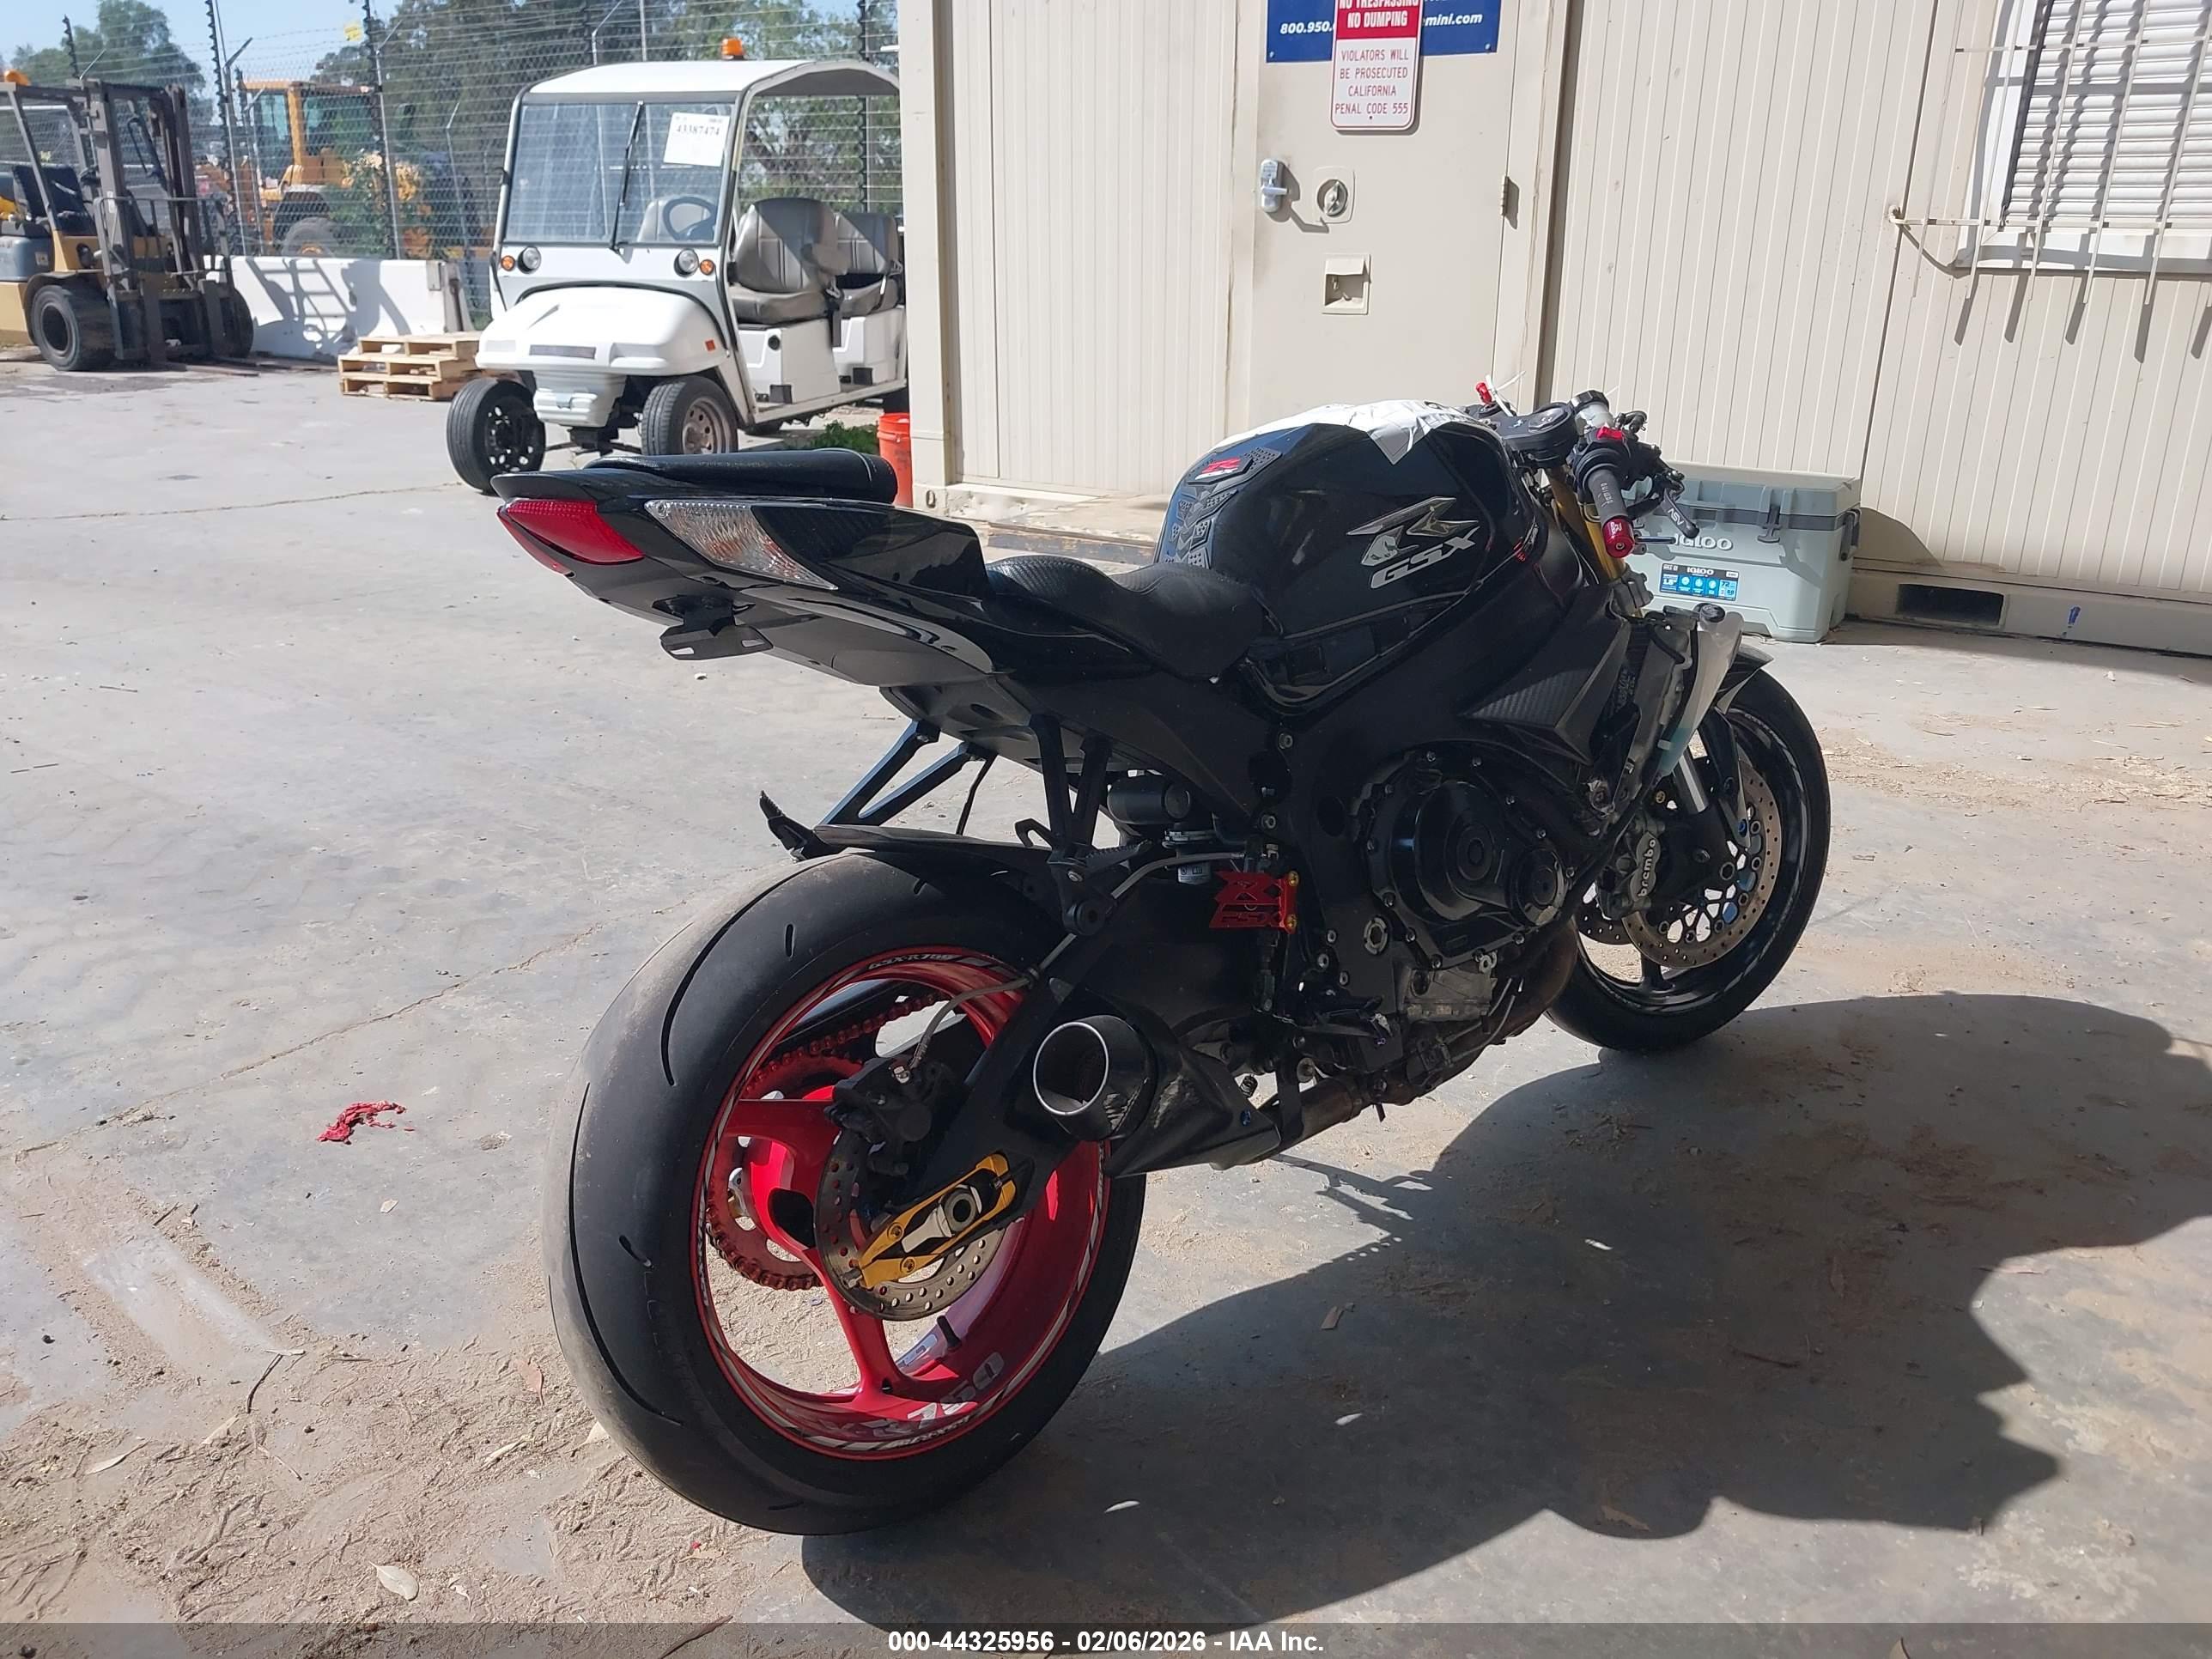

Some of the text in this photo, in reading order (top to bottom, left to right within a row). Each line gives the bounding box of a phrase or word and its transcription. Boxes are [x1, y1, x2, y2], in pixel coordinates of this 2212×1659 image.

[1340, 0, 1353, 9] NO
[1347, 10, 1408, 28] NO DUMPING
[1422, 12, 1483, 27] mini.com
[1279, 21, 1335, 34] 800.950.
[1340, 48, 1409, 62] VIOLATORS WILL
[1340, 67, 1408, 79] BE PROSECUTED
[1348, 85, 1396, 97] CALIFORNIA
[1334, 102, 1408, 115] PENAL CODE 555
[1668, 507, 1684, 526] ASV
[1675, 533, 1733, 550] IGLOO
[1370, 526, 1480, 588] GSX
[1686, 567, 1714, 575] IGLOO
[1638, 839, 1656, 897] brembo
